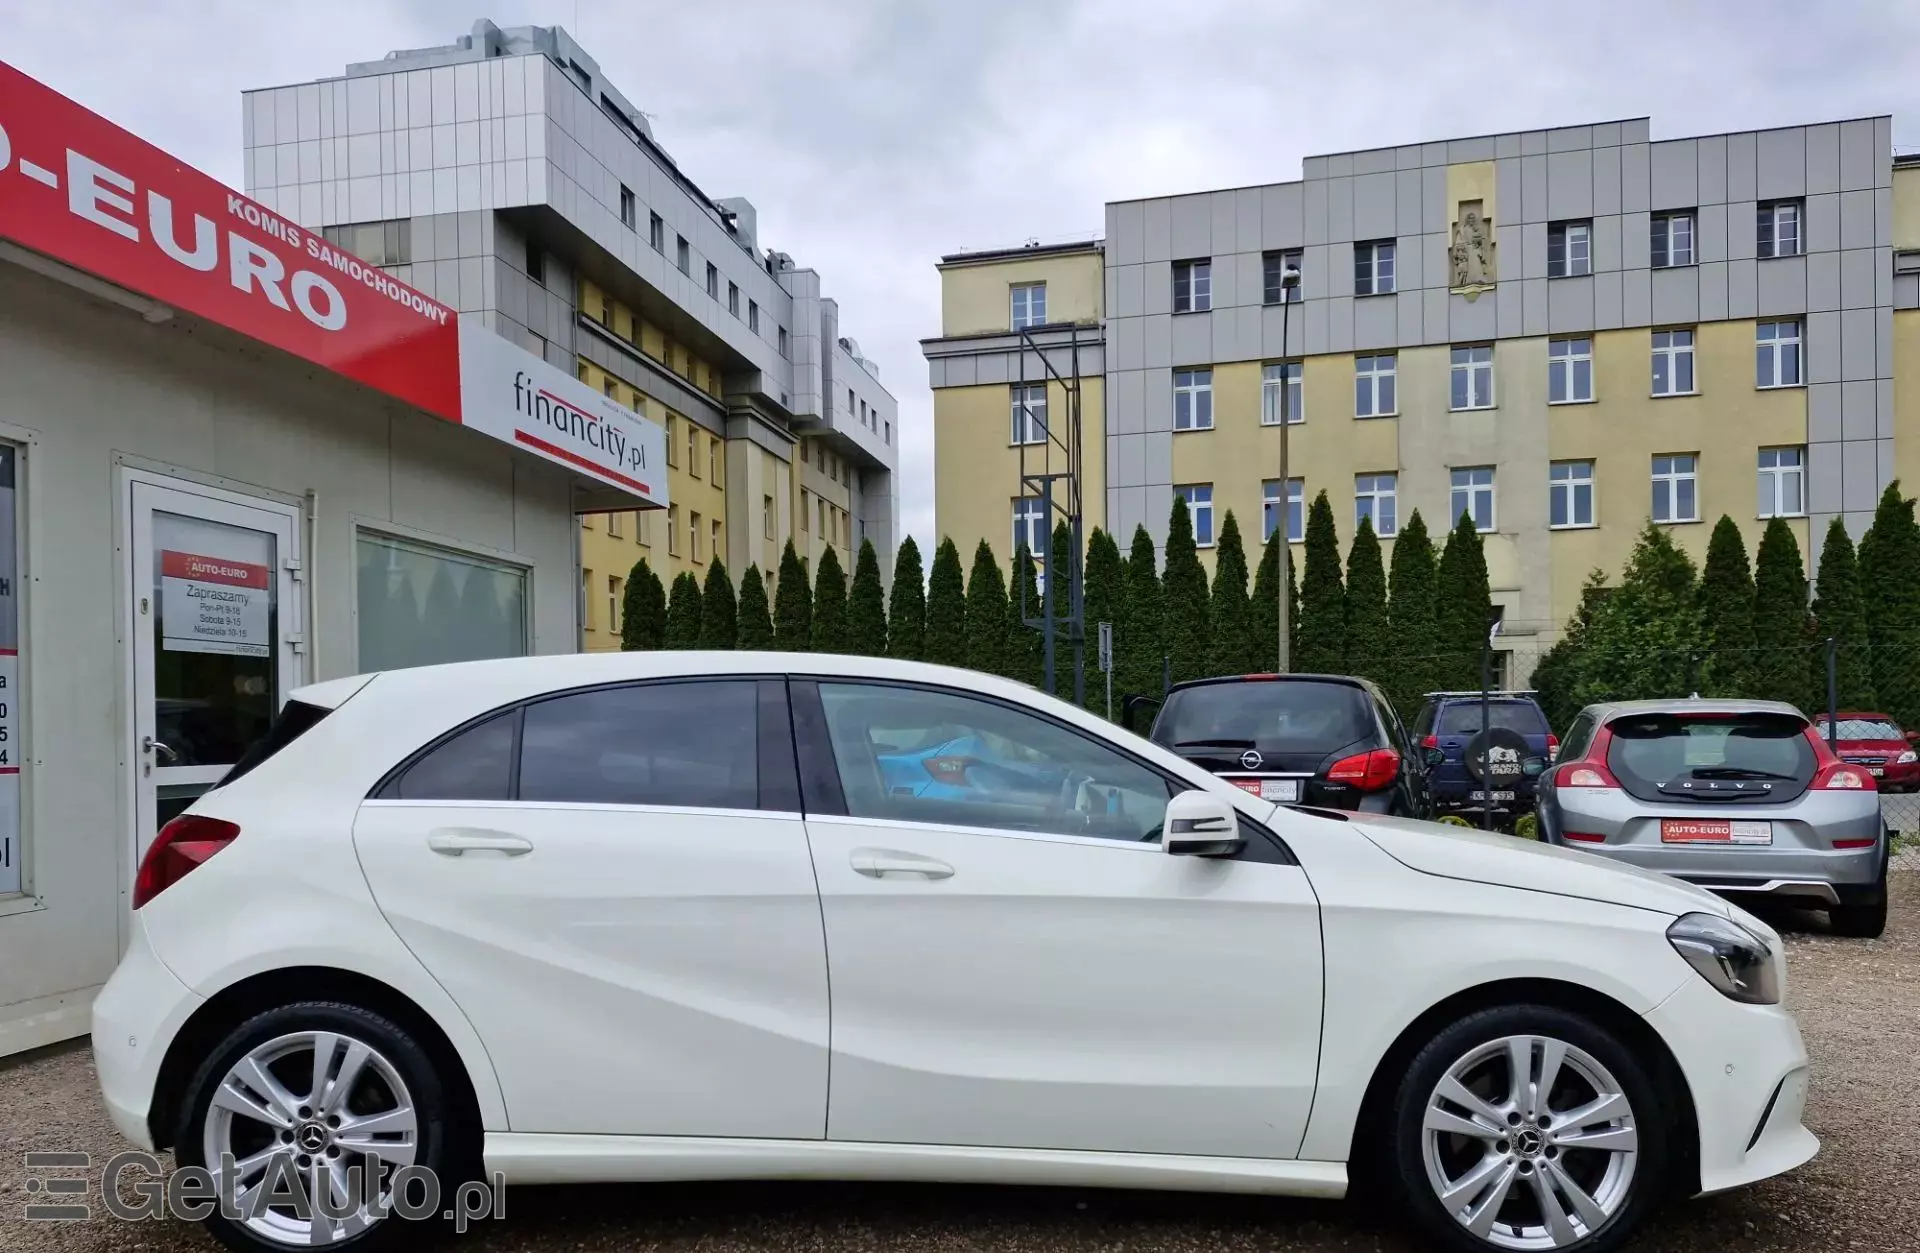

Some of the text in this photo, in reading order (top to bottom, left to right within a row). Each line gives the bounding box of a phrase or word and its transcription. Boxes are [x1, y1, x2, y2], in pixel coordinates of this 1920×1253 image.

[0, 124, 346, 331] -EURO
[228, 194, 448, 325] KOMIS SAMOCHODOWY
[514, 371, 645, 471] financity.pl
[191, 562, 248, 579] AUTO-EURO
[187, 584, 249, 607] Zapraszamy
[200, 613, 225, 625] Sobota
[1668, 826, 1729, 834] AUTO-EURO
